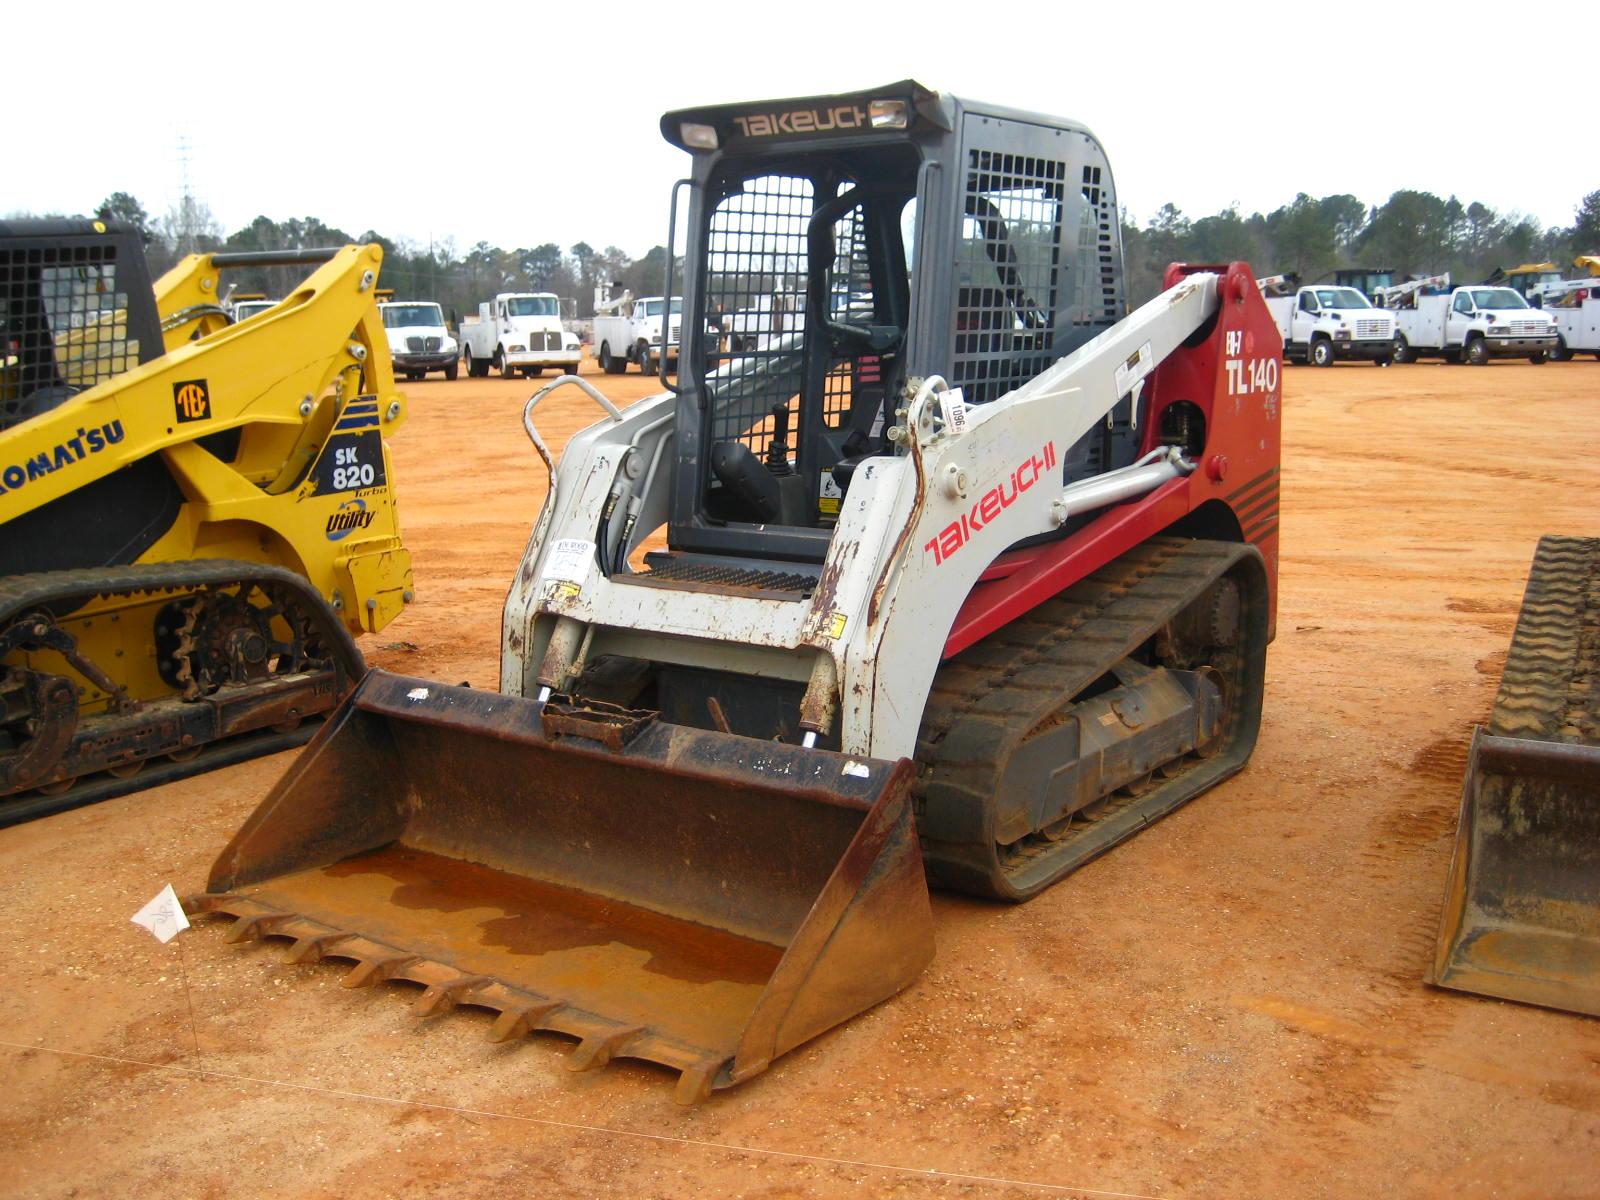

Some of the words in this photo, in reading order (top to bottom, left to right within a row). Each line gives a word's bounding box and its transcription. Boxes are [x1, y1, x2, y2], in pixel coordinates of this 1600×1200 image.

[733, 105, 866, 137] TAKEUCH
[335, 446, 358, 465] SK
[333, 463, 375, 490] 820
[326, 510, 376, 533] Utility
